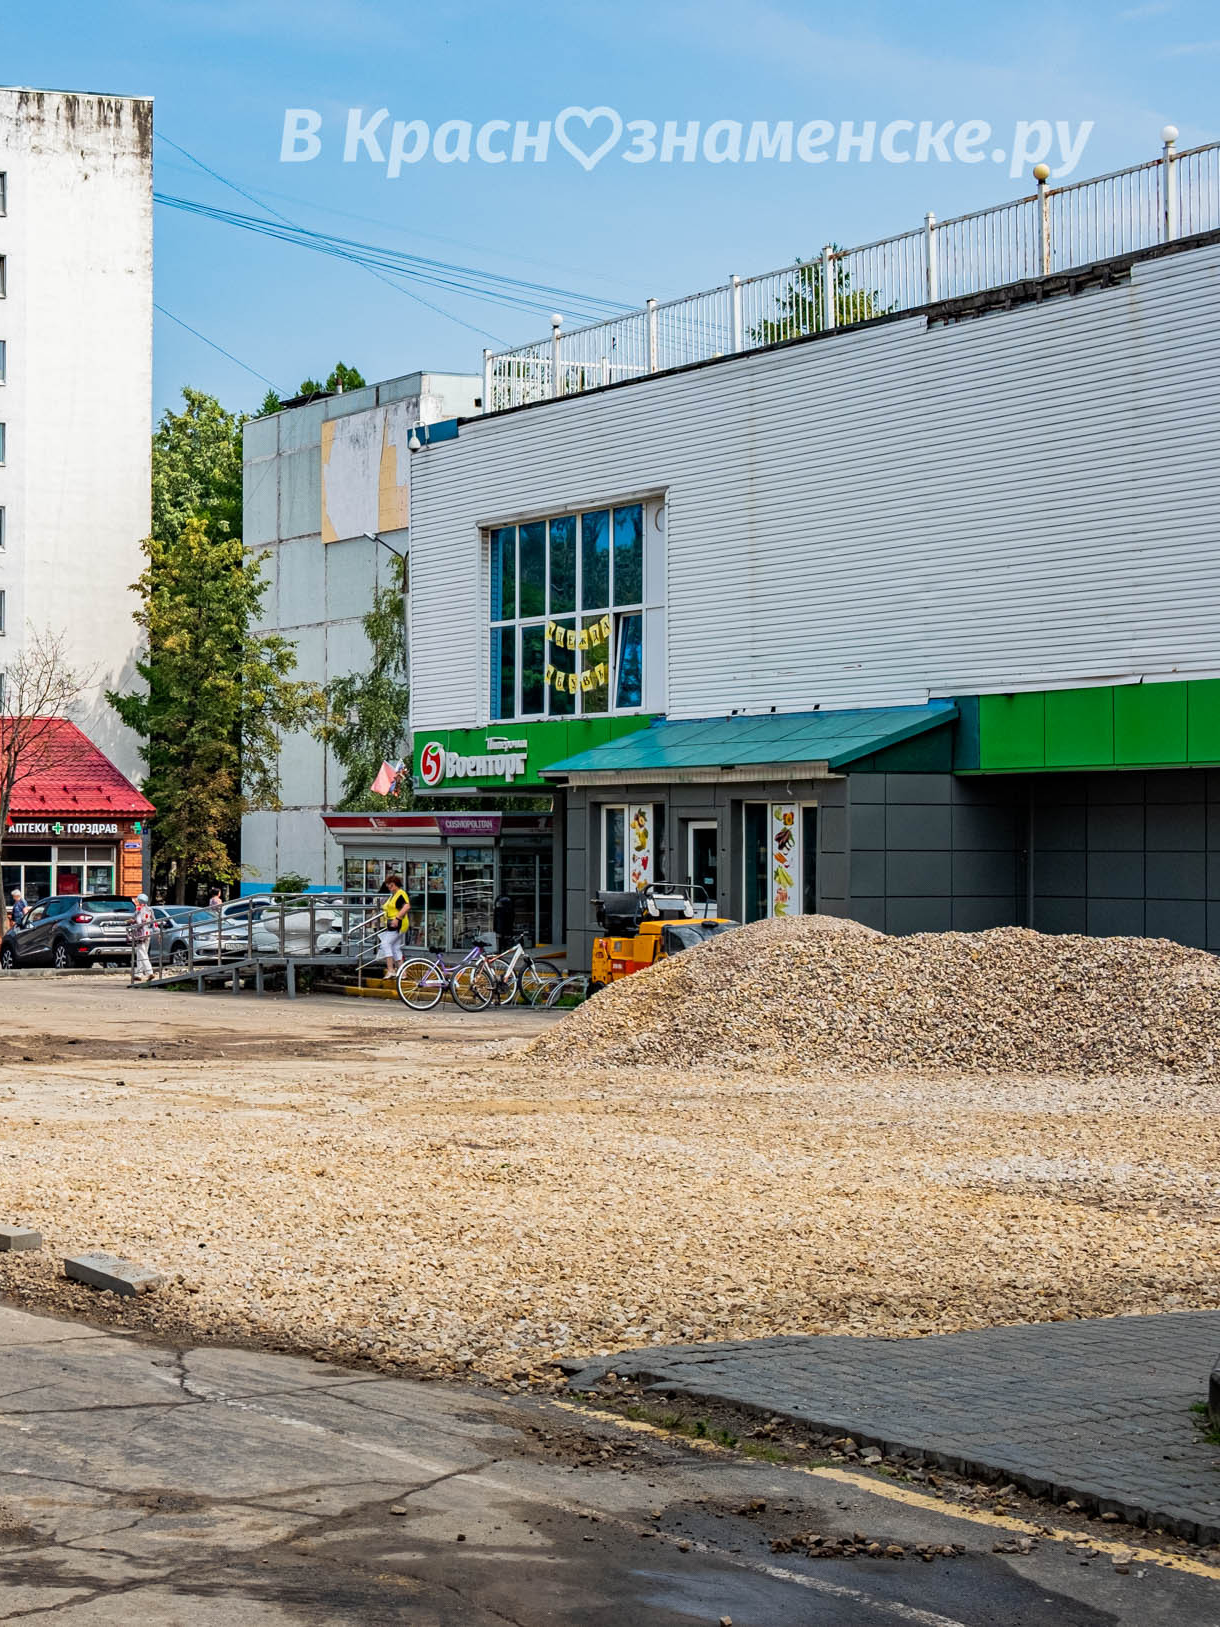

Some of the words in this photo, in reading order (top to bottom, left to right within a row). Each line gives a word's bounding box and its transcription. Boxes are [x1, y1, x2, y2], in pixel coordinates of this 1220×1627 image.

[445, 752, 528, 783] Военторг
[8, 823, 49, 833] АПТЕКИ
[67, 823, 118, 834] ГОРЗДРАВ
